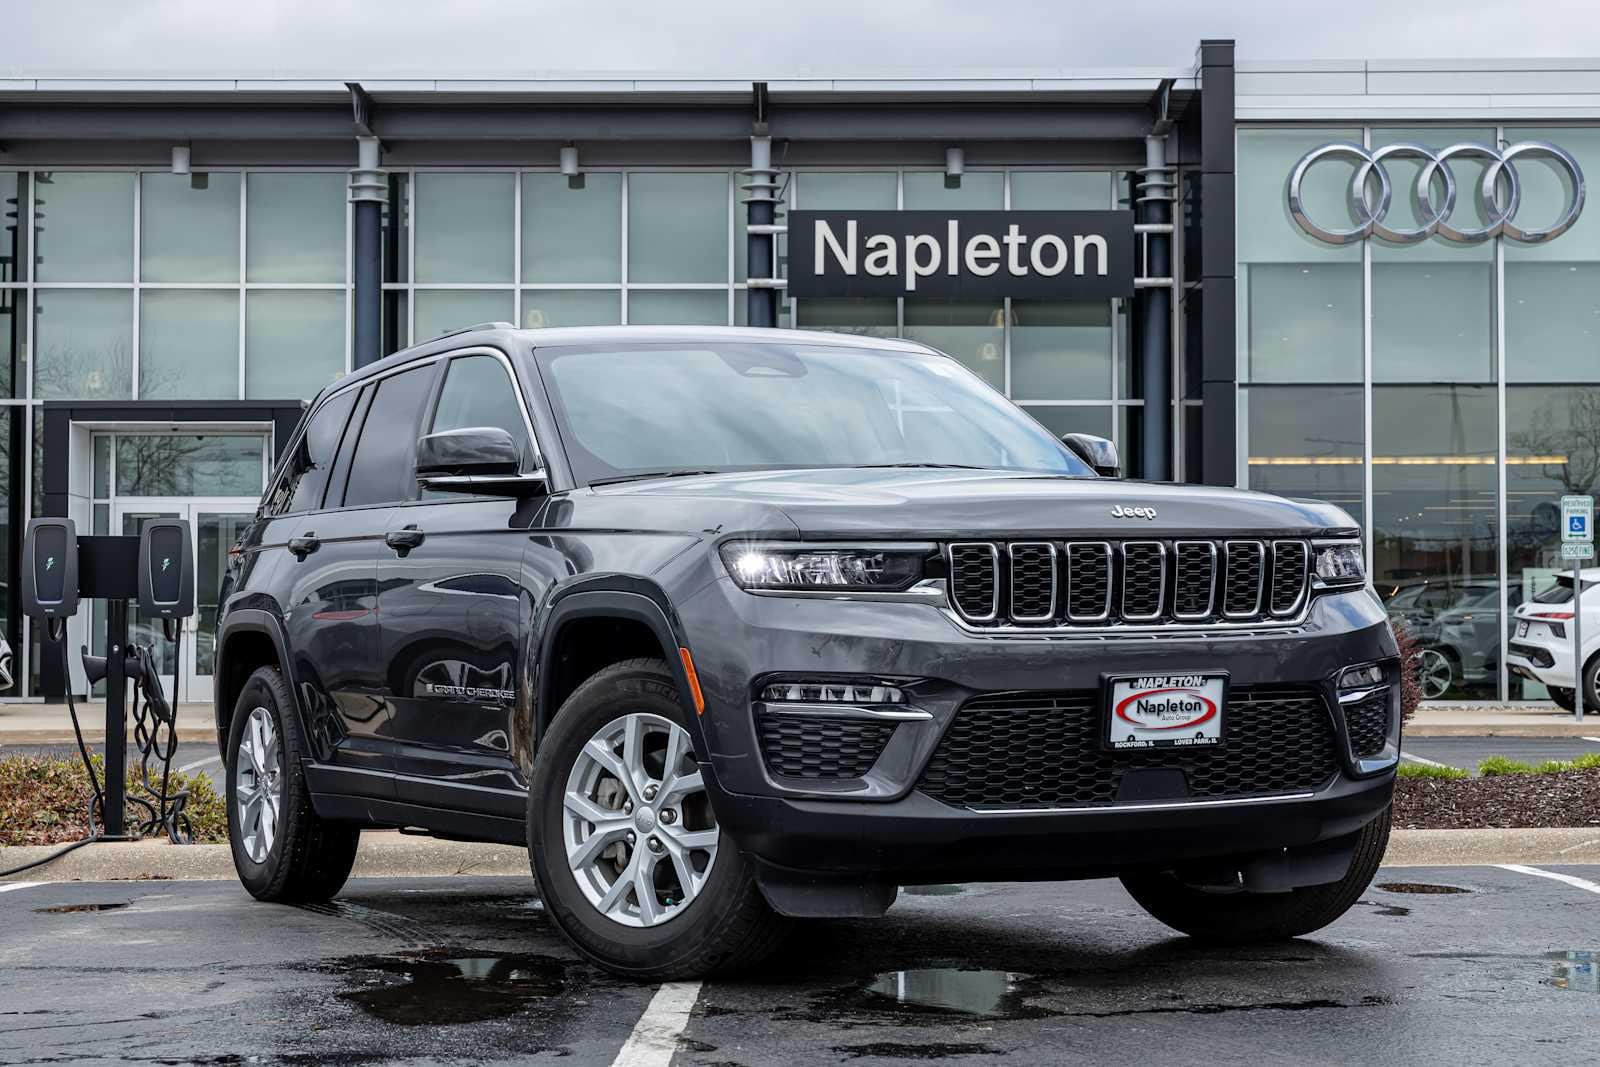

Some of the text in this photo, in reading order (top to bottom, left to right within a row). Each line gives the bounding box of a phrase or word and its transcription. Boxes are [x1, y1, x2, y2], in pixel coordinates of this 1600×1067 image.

[814, 219, 1108, 291] Napleton
[1111, 504, 1157, 520] Jeep
[1137, 676, 1202, 689] NAPLETON
[434, 684, 515, 699] GRAND CHEROKEE
[1136, 699, 1202, 716] Napleton
[1176, 713, 1191, 721] Group
